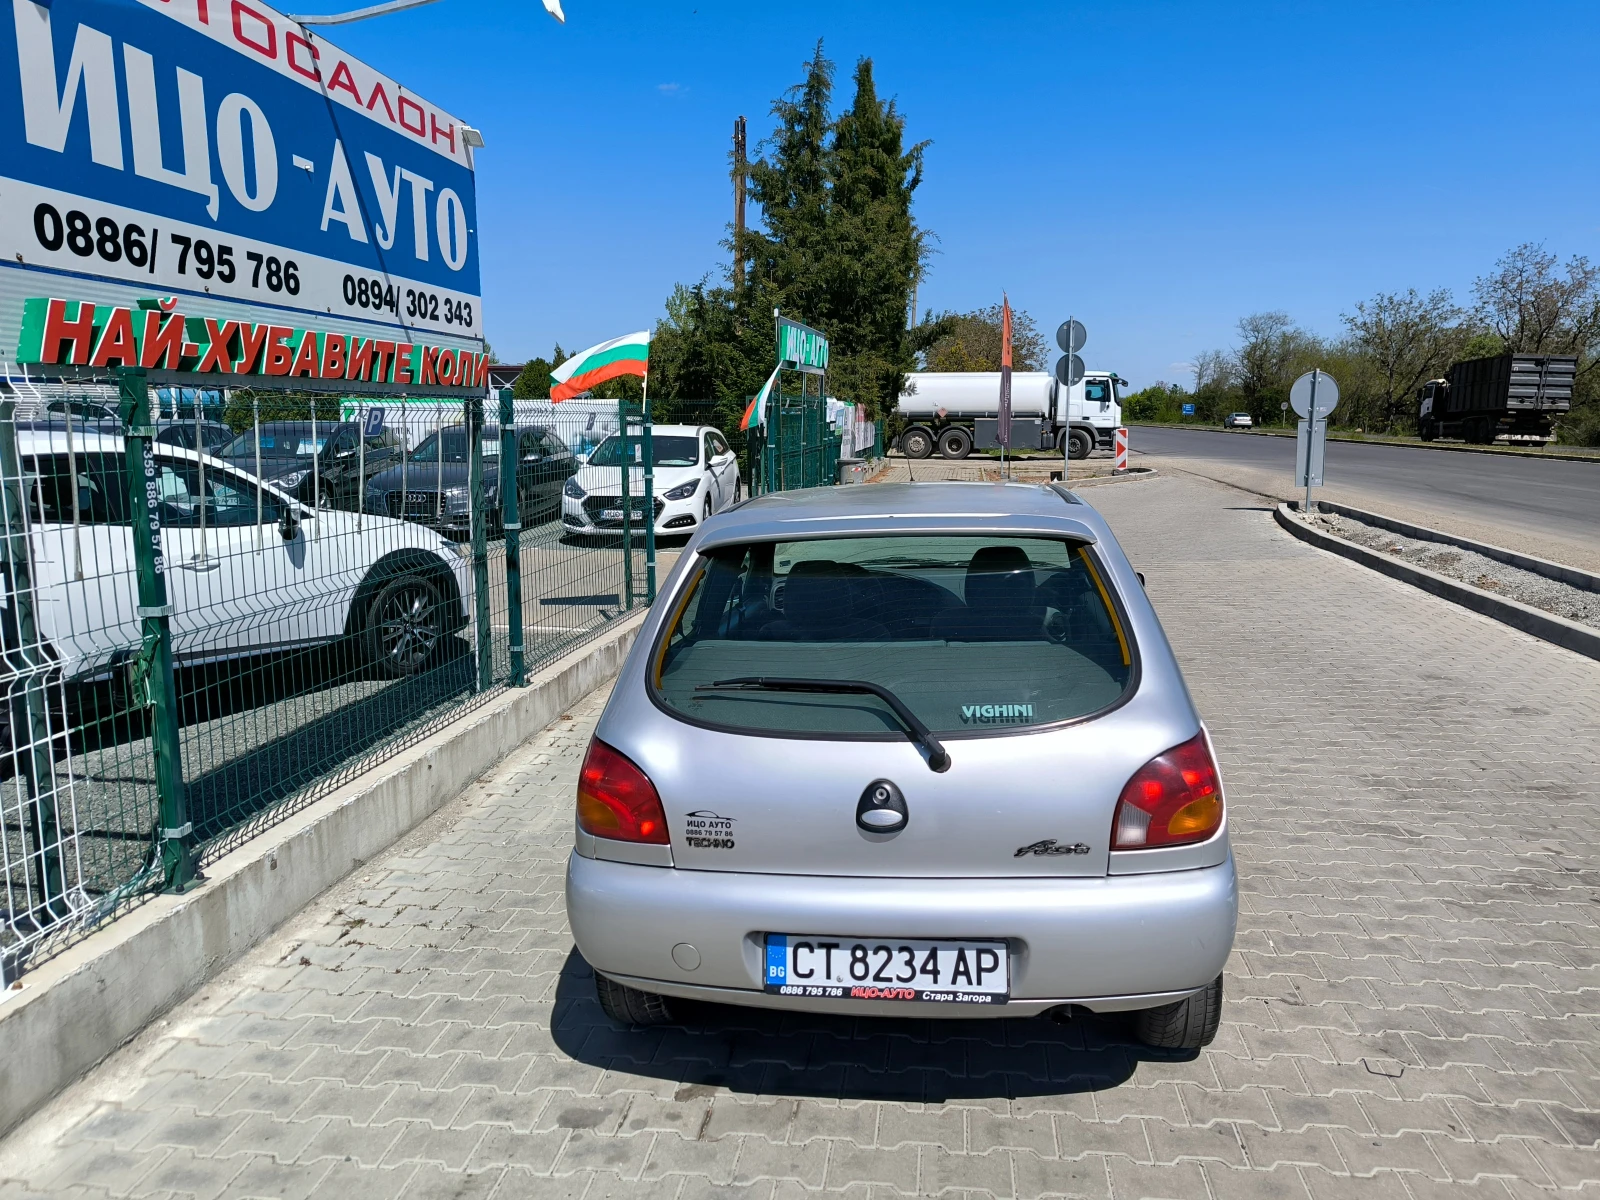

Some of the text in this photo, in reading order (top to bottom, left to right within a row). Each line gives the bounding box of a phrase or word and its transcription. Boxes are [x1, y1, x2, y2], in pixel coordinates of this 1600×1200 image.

[170, 233, 236, 284] 795
[246, 250, 300, 295] 786
[406, 289, 439, 321] 302
[444, 298, 472, 327] 343
[40, 297, 489, 388] НАЙ-ХУБАВИТЕ КОЛИ
[143, 441, 164, 574] +359 886 79 57 86
[961, 704, 1033, 718] VIGHINI
[687, 820, 706, 828] ИЦО
[769, 966, 785, 977] BG
[792, 942, 999, 986] CT 8234 AP
[780, 985, 992, 1003] 0886 795 786 ИЦО-АУТО Стара Загора
